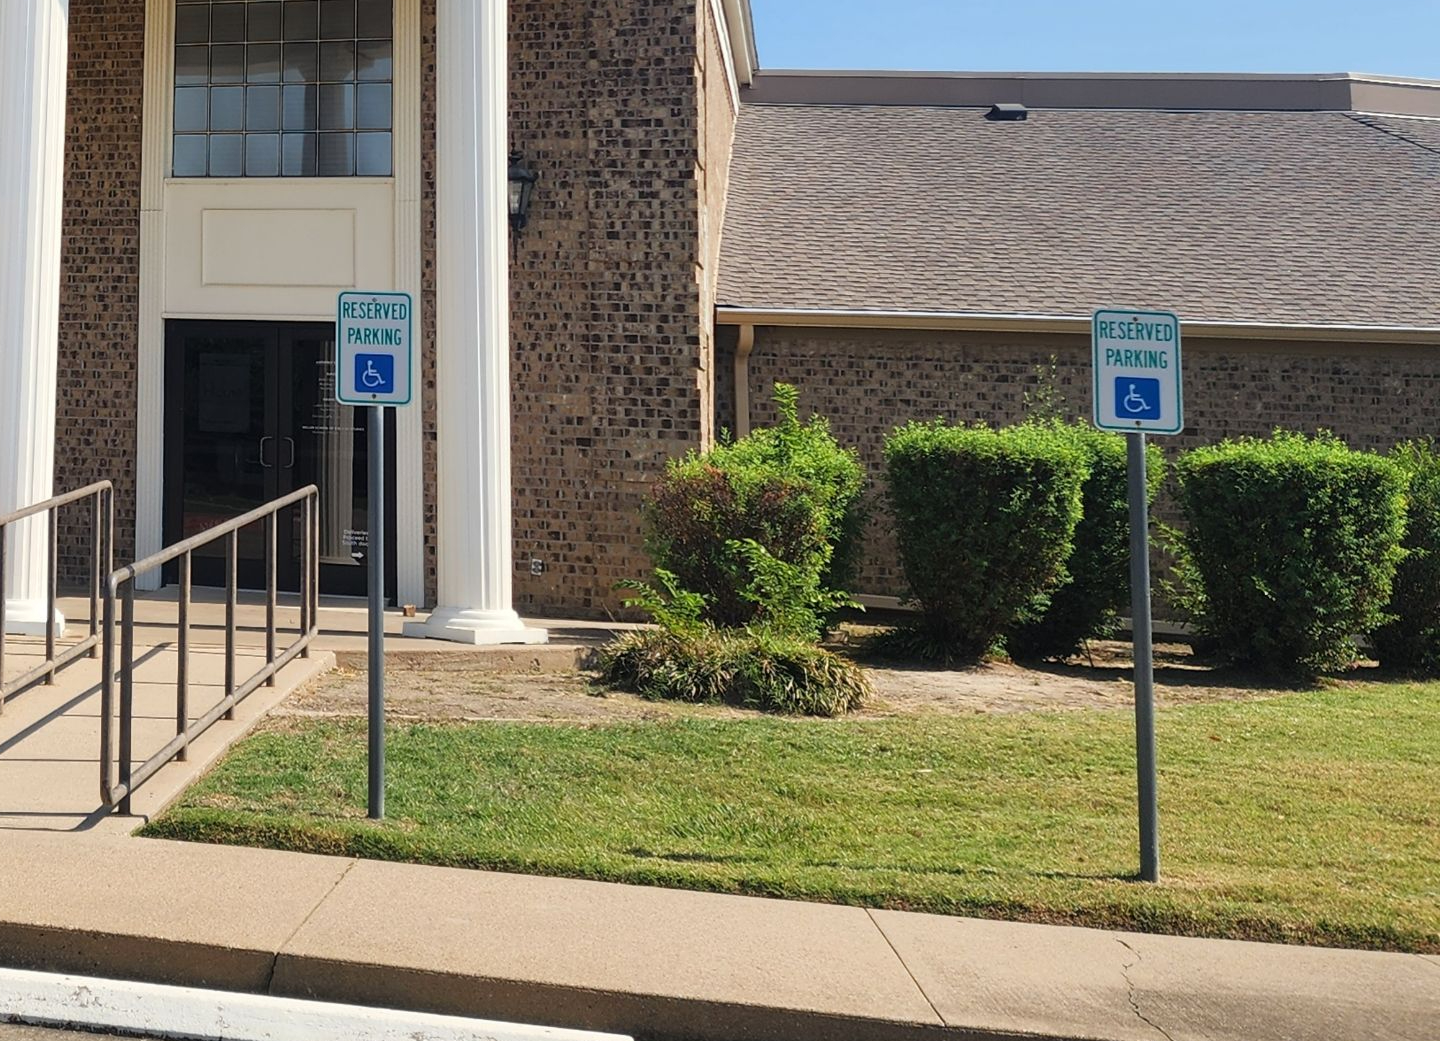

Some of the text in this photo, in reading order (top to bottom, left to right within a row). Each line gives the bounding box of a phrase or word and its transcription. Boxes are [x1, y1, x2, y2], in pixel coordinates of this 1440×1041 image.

[343, 301, 407, 320] RESERVED
[347, 327, 402, 346] PARKING
[1100, 321, 1173, 342] RESERVED
[1106, 348, 1168, 369] PARKING
